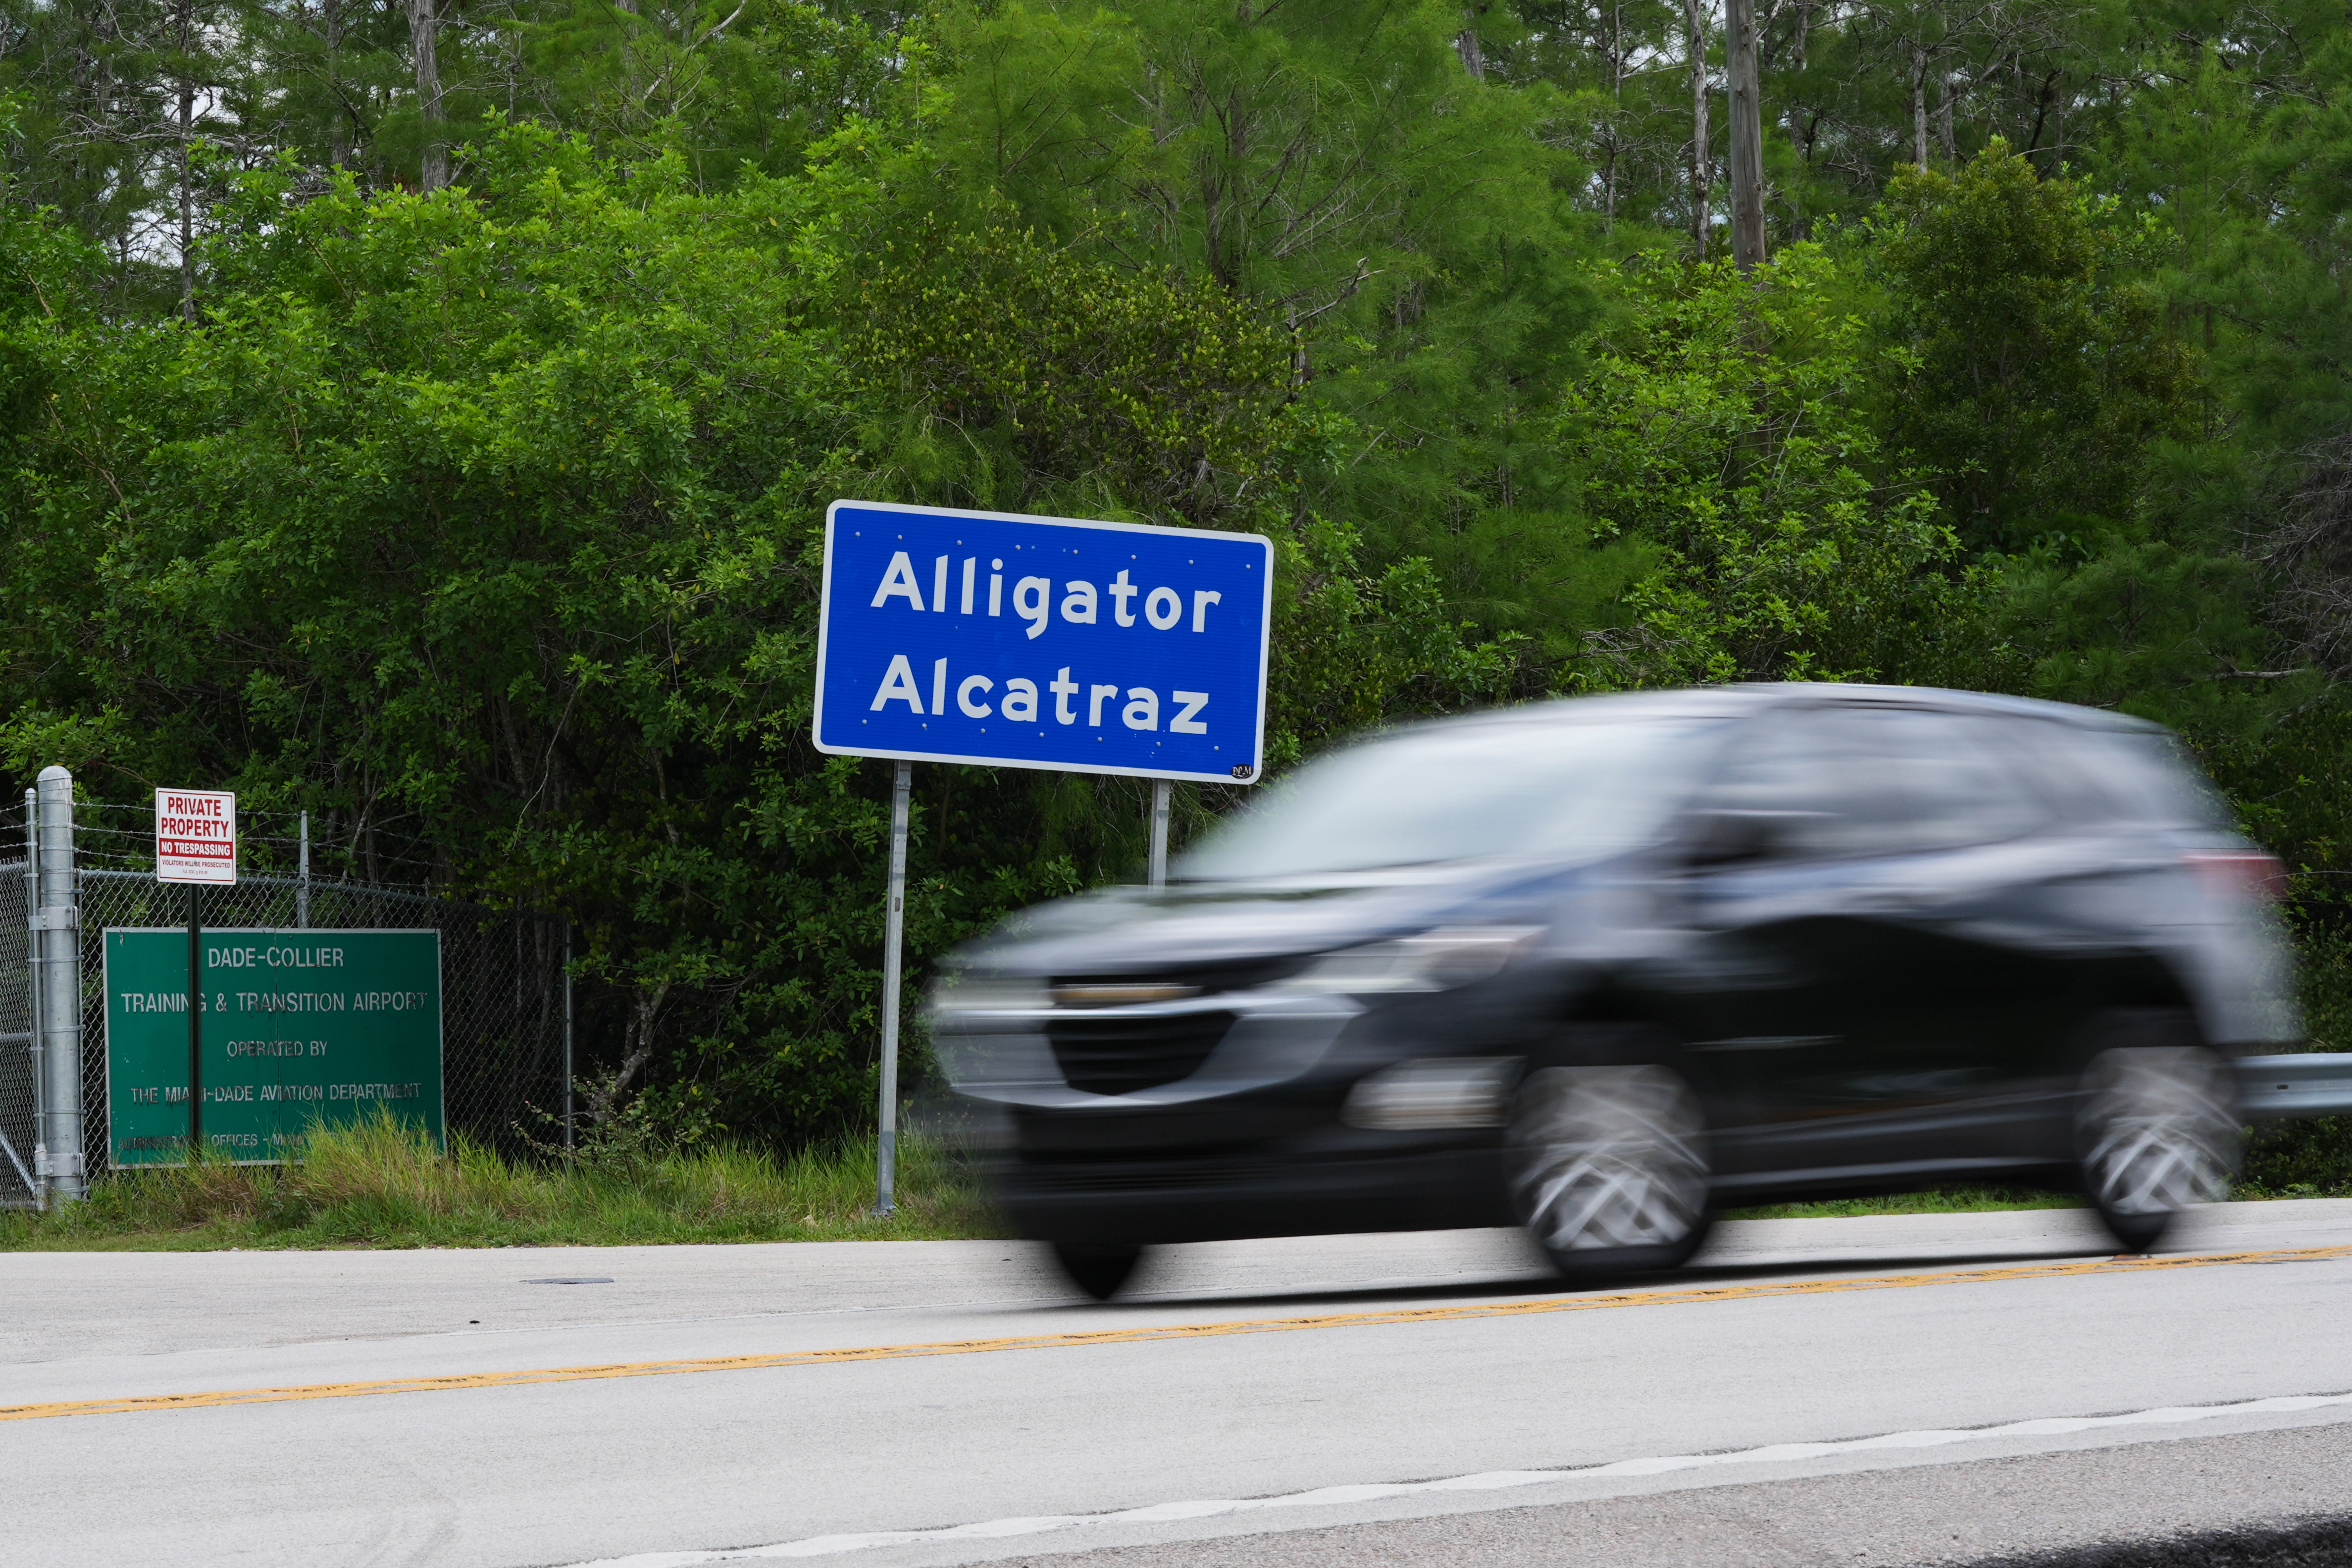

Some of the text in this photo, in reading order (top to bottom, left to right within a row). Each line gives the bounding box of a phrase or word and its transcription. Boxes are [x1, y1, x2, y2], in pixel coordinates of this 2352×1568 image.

[870, 551, 1222, 640] Alligator
[869, 655, 1209, 735] Alcatraz
[168, 796, 221, 816] PRIVATE
[161, 817, 229, 837] PROPERTY
[161, 841, 231, 857] NO TRESPASSING
[208, 946, 344, 968] DADE-COLLIER
[215, 993, 228, 1012] &
[236, 992, 345, 1013] TRANSITION
[353, 991, 428, 1012] AIRPORT
[227, 1040, 328, 1057] OPERATED BY
[130, 1082, 422, 1104] THE MIAI-DADE AVIATION DEPARTMENT
[211, 1133, 258, 1147] OFFICES
